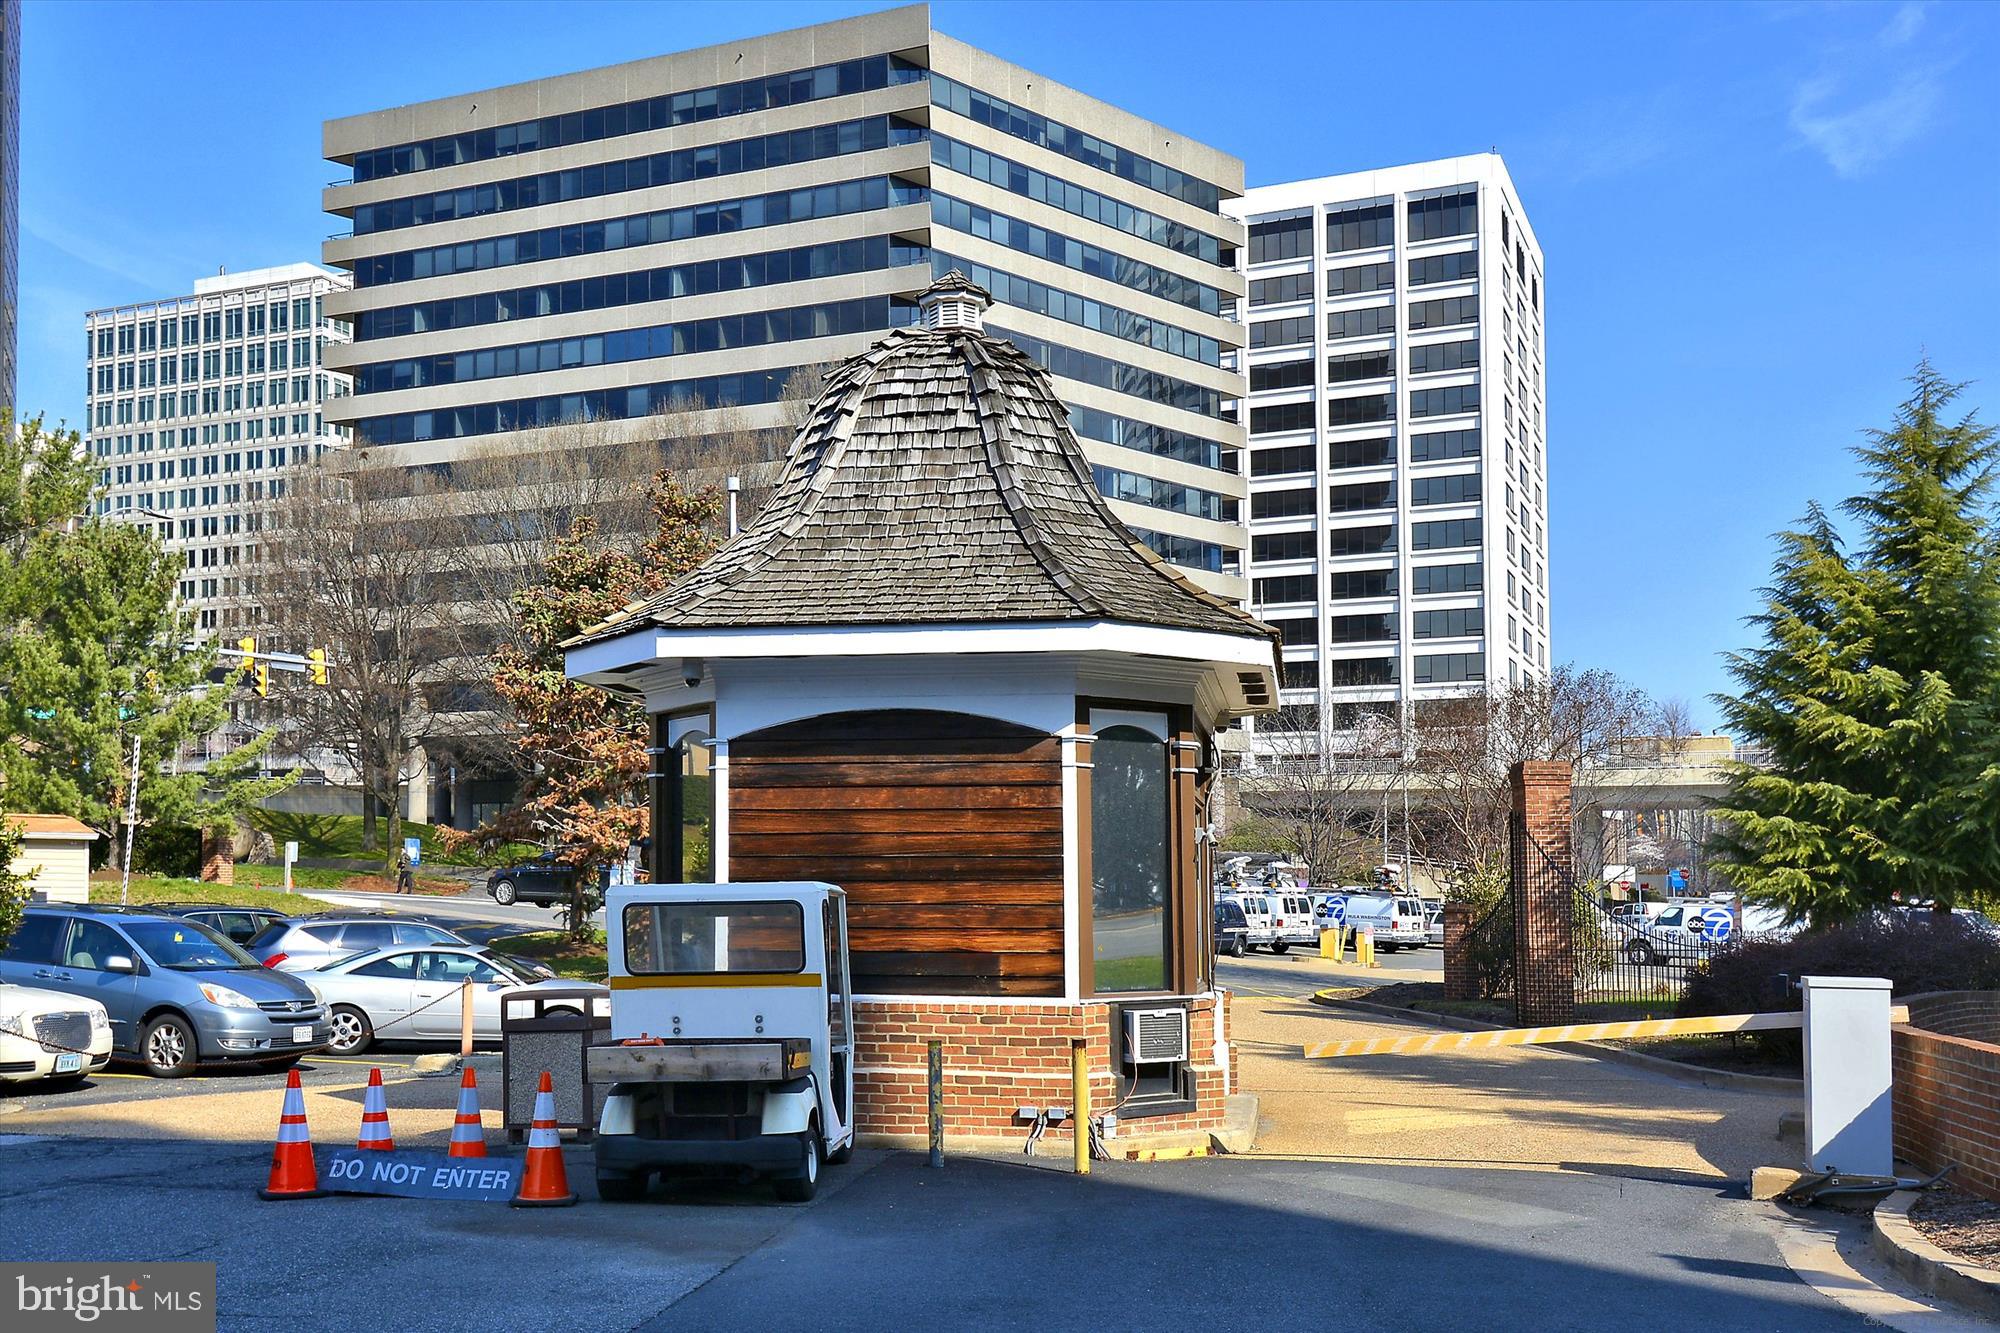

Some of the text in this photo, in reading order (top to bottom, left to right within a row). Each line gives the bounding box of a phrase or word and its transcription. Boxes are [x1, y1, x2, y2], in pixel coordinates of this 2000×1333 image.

[1687, 920, 1706, 928] abc
[329, 1159, 511, 1190] DO NOT ENTER
